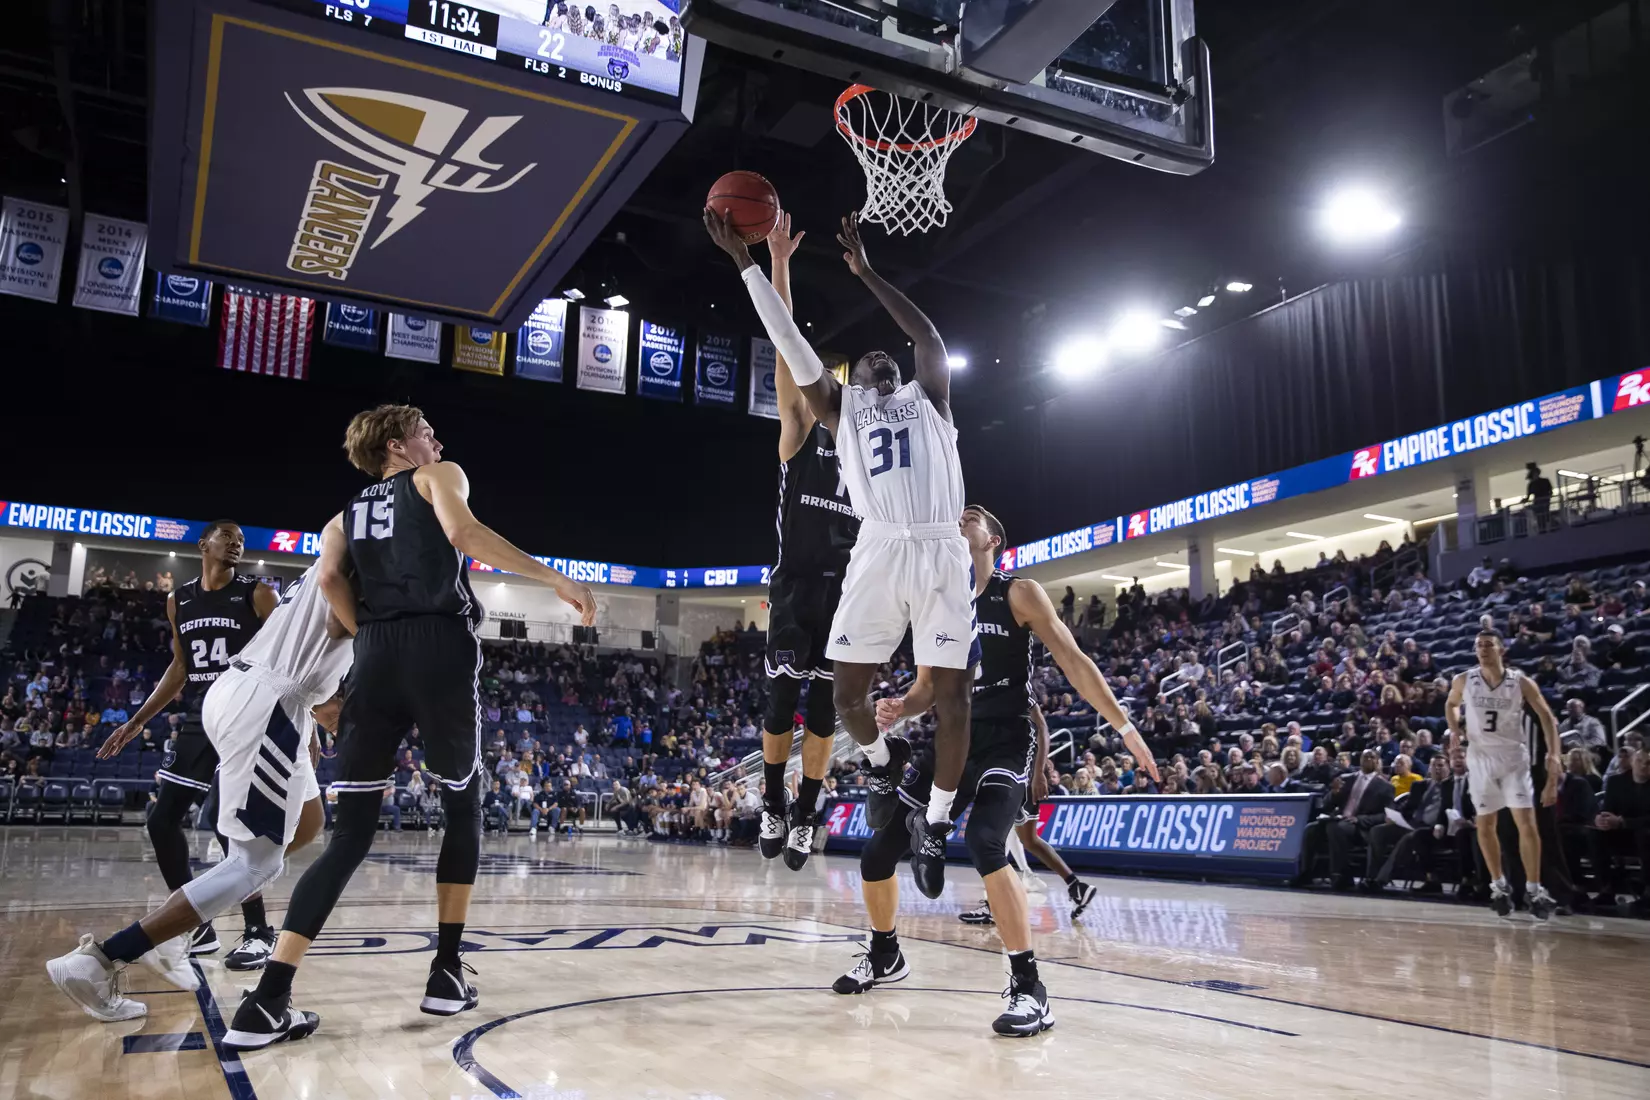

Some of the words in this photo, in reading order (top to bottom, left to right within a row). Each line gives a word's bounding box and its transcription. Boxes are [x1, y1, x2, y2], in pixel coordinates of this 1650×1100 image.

[325, 5, 353, 21] FLS
[364, 15, 373, 27] 7
[429, 0, 480, 36] 11:34
[422, 31, 444, 45] 1ST
[537, 30, 565, 61] 22
[525, 58, 549, 74] FLS
[559, 67, 566, 78] 2
[580, 72, 622, 93] BONUS
[16, 207, 54, 223] 2015
[286, 160, 389, 280] LANCERS
[3, 227, 62, 245] BASKETBALL
[17, 221, 47, 233] MEN'S
[97, 223, 132, 239] 2014
[98, 237, 127, 247] MEN'S
[523, 321, 563, 333] ASKETBALL
[650, 324, 676, 337] 2017
[392, 331, 411, 342] WEST
[412, 333, 438, 344] REGION
[392, 338, 435, 351] CHAMPIONS
[645, 333, 679, 345] WOMEN'S
[706, 335, 731, 348] 2017
[516, 355, 561, 368] CHAMPIONS
[1352, 450, 1376, 477] 2K
[1383, 426, 1450, 472] EMPIRE
[1452, 402, 1536, 453] CLASSIC
[869, 427, 912, 478] 31
[800, 494, 864, 521] ARKANSA
[1128, 514, 1146, 537] 2K
[1150, 498, 1194, 533] EMPIRE
[1195, 483, 1250, 521] CLASSIC
[8, 503, 76, 531] EMPIRE
[79, 511, 152, 539] CLASSIC
[352, 495, 394, 540] 15
[272, 531, 297, 552] 2K
[1017, 538, 1051, 568] EMPIRE
[1051, 527, 1092, 558] CLASSIC
[553, 558, 609, 584] CLASSIC
[704, 569, 738, 586] CBU
[489, 610, 527, 619] GLOBALLY
[180, 616, 241, 635] CENTRAL
[191, 637, 230, 669] 24
[188, 671, 223, 682] ARKAN
[1482, 710, 1499, 733] 3
[828, 805, 848, 834] 2K
[1048, 804, 1131, 848] EMPIRE
[1127, 804, 1234, 852] CLASSIC
[1239, 815, 1296, 827] WOUNDED
[1236, 827, 1287, 839] WARRIOR
[1232, 838, 1282, 852] PROJECT
